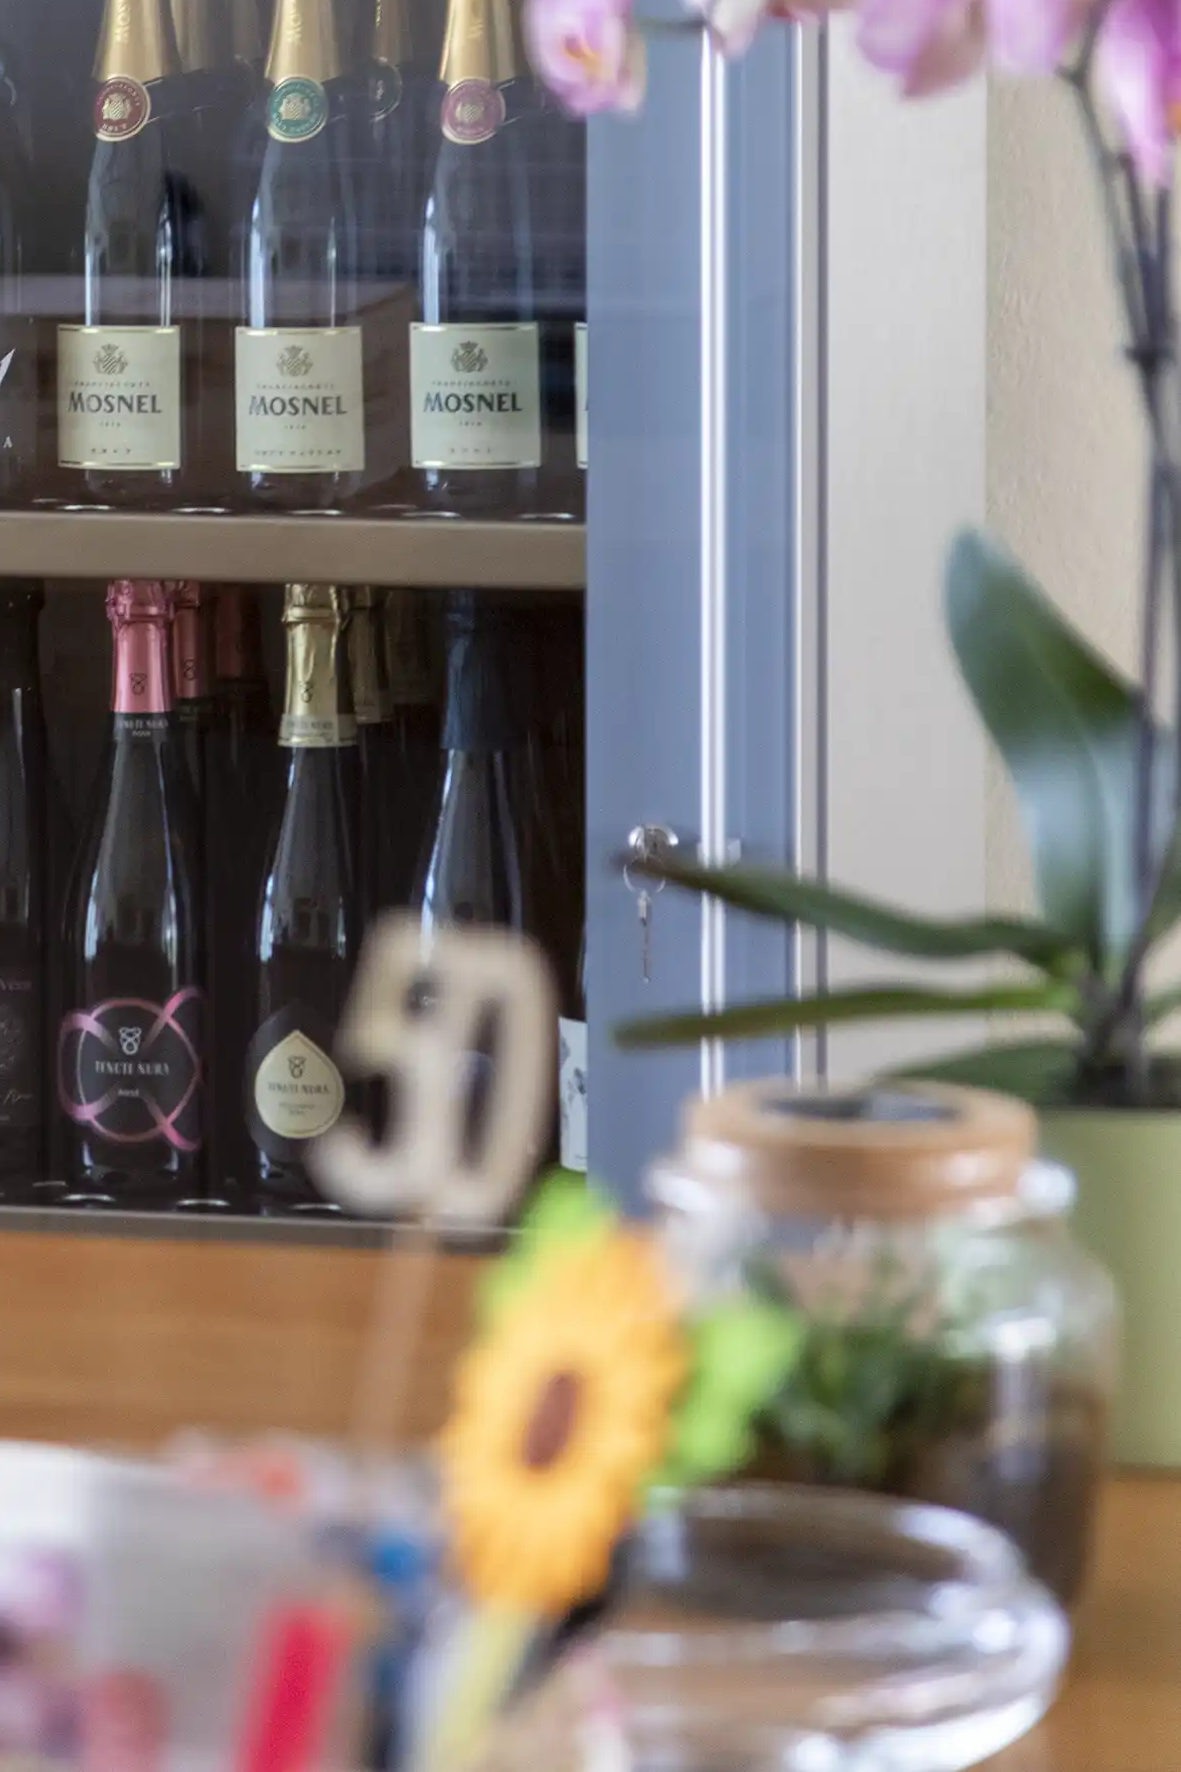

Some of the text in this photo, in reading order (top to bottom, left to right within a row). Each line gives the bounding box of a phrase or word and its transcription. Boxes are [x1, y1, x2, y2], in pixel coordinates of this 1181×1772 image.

[68, 391, 162, 414] MOSNEL
[249, 394, 348, 416] MOSNEL
[423, 391, 523, 413] MOSNEL
